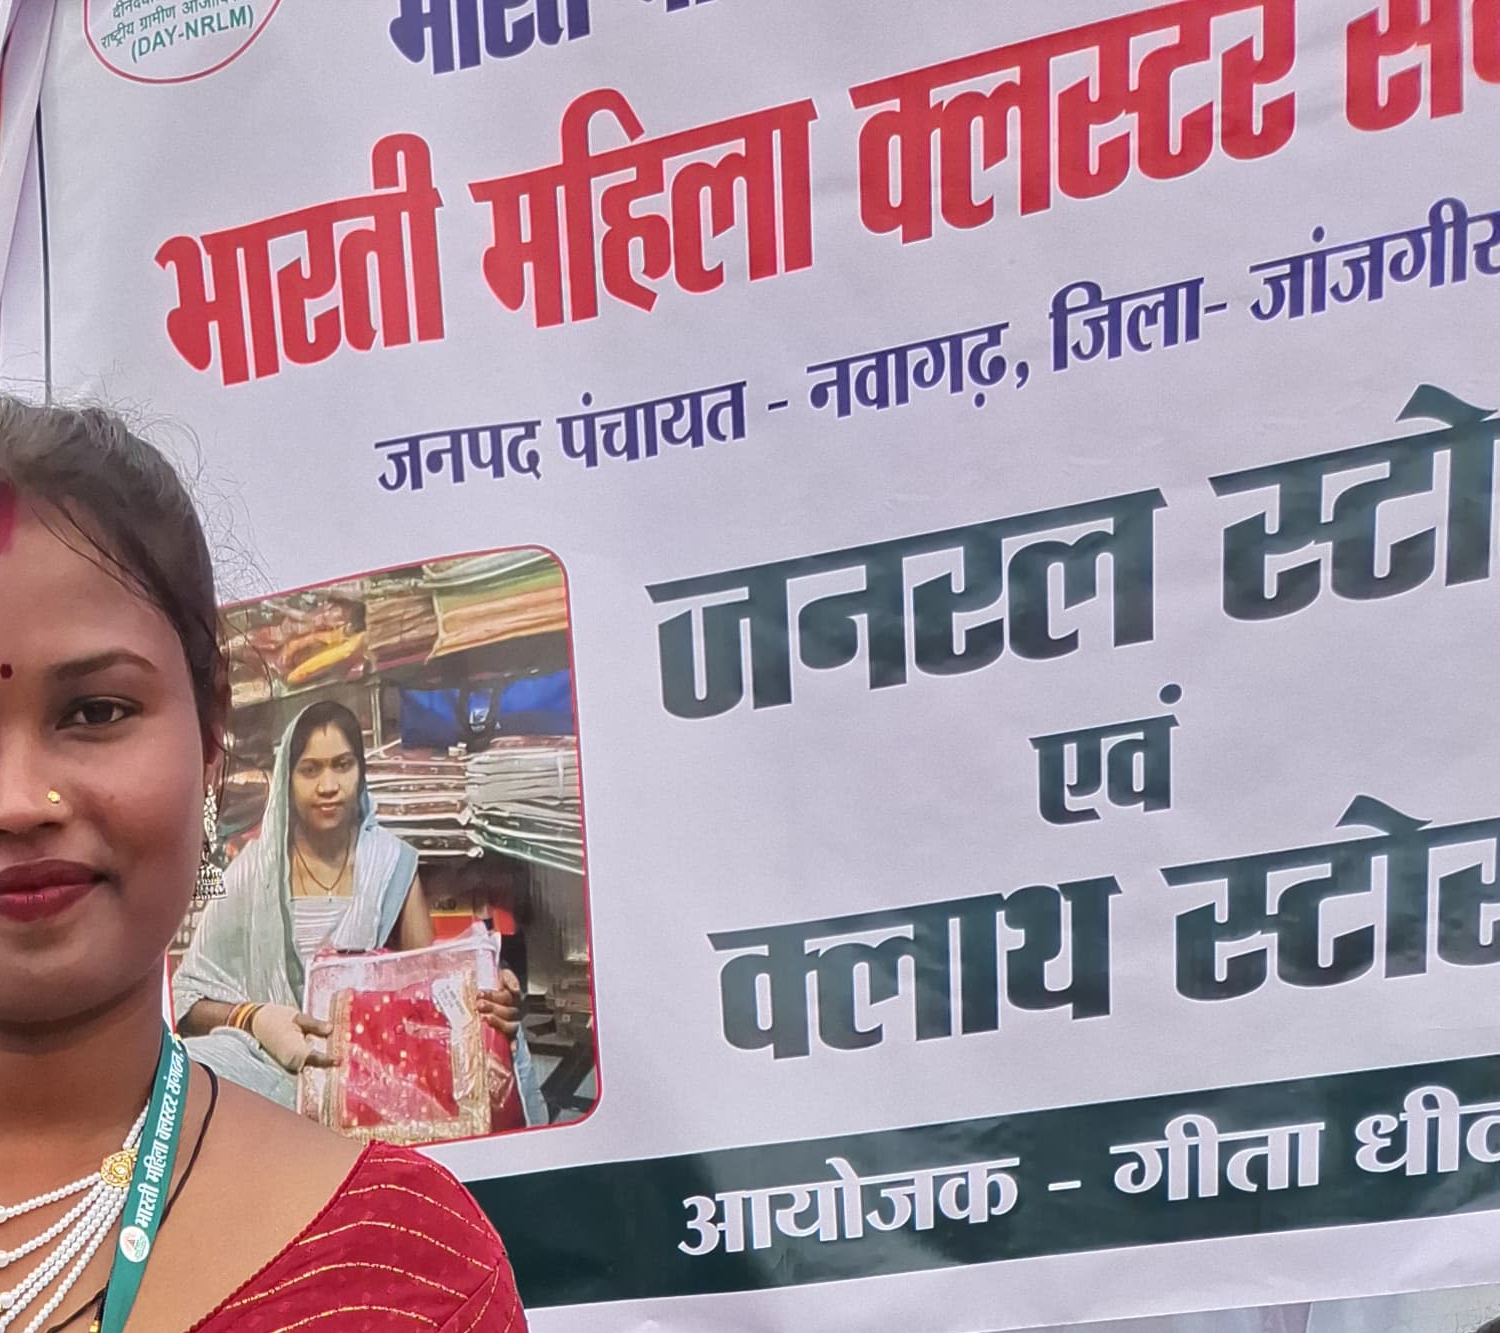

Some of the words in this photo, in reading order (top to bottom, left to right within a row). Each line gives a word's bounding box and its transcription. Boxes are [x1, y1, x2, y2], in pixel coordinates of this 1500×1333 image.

[131, 4, 254, 63] (DAY-NRLM)
[156, 132, 446, 387] भारती
[469, 88, 818, 328] महिला
[375, 418, 541, 493] जनपद
[558, 377, 748, 472] पंचायत
[645, 486, 1168, 721] जनरल
[1027, 683, 1183, 827] एवं
[707, 874, 1122, 1061] क्लाथ
[143, 1139, 169, 1183] महिला
[156, 1092, 178, 1141] क्लस्टर
[135, 1182, 160, 1228] भारती
[677, 1155, 1021, 1257] आयोजक
[1109, 1114, 1325, 1201] गीता
